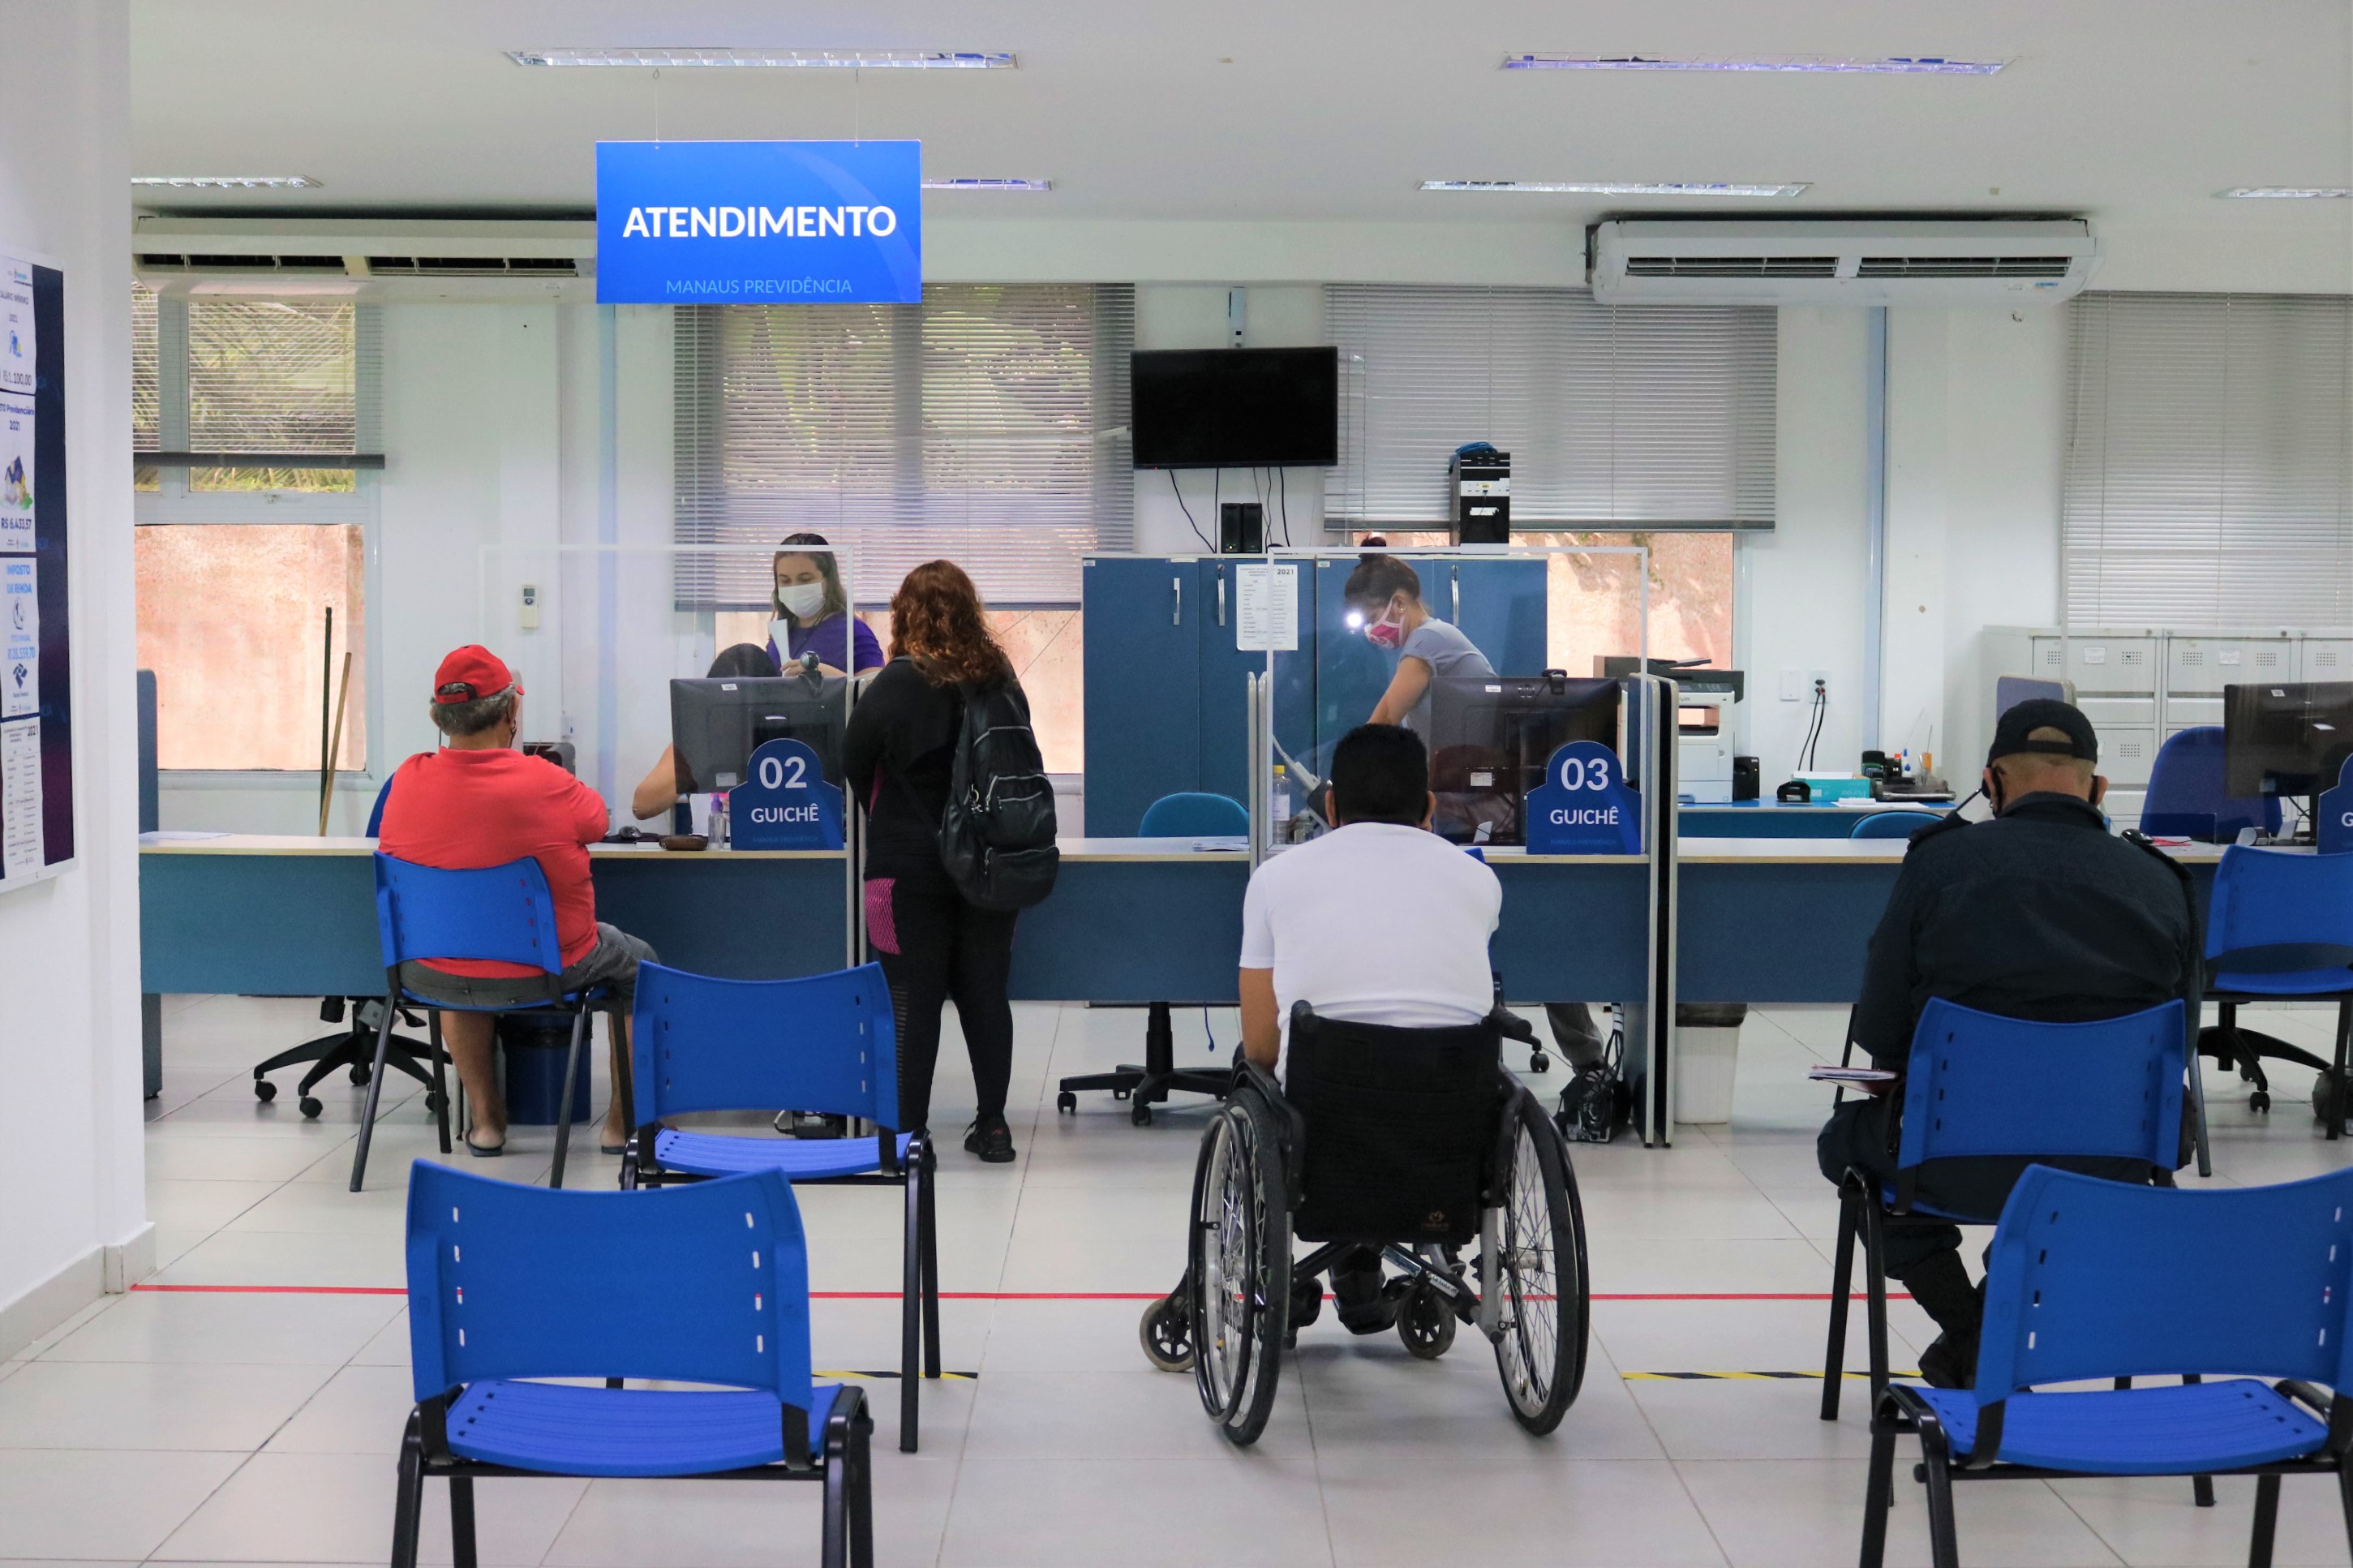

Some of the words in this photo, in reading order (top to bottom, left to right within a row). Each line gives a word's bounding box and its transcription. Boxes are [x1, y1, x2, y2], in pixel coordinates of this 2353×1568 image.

[622, 205, 896, 238] ATENDIMENTO
[666, 279, 739, 294] MANAUS
[745, 276, 852, 294] PREVIDÊNCIA
[759, 756, 807, 789] 02
[1561, 758, 1608, 791] 03
[751, 803, 819, 823] GUICHÊ
[1550, 806, 1619, 825] GUICHÊ
